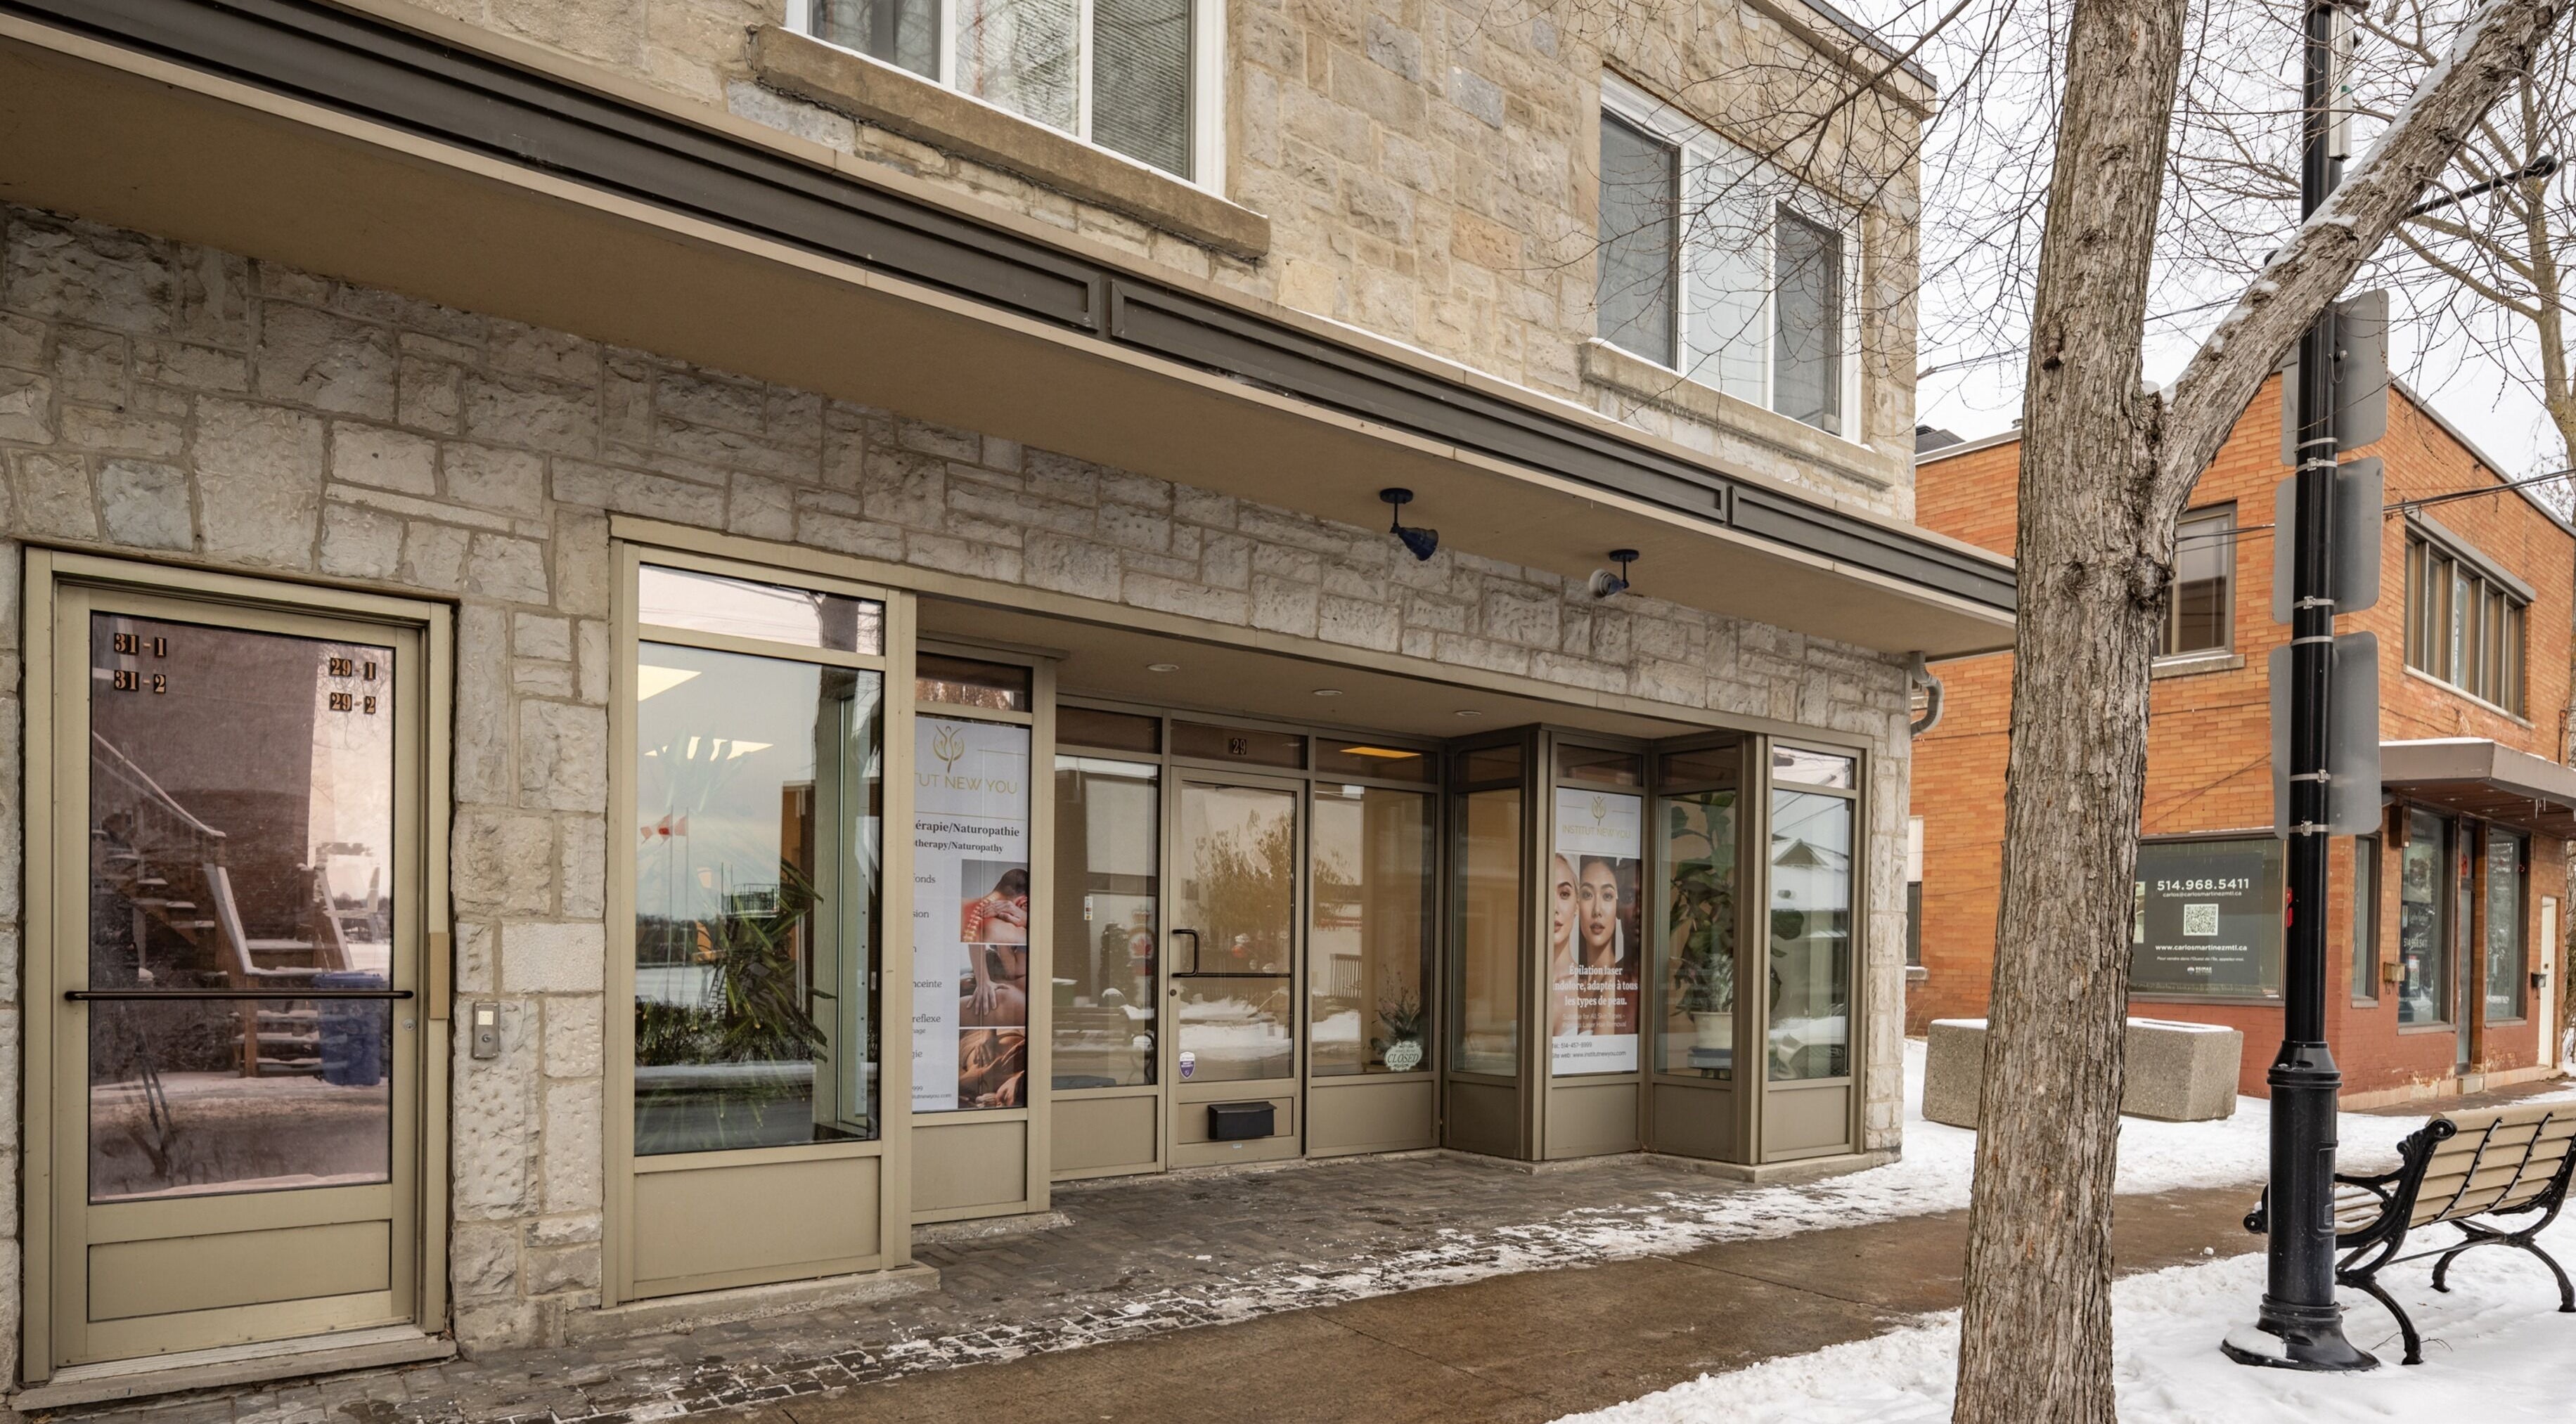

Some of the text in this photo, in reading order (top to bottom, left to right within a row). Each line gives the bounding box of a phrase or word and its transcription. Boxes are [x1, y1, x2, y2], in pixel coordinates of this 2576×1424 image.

[115, 633, 165, 656] 31-1
[331, 659, 375, 680] 29-1
[115, 671, 165, 693] 31-2
[331, 693, 375, 713] 29-2
[1232, 739, 1247, 755] 29
[945, 775, 982, 791] NEW
[986, 779, 1018, 795] YOU
[1561, 824, 1631, 839] INSTITUT NEW YOU
[2157, 878, 2249, 891] 514.968.5411
[1569, 962, 1623, 976] Épilation laser
[1587, 980, 1615, 992] adaptée
[1616, 980, 1621, 990] à
[1623, 981, 1638, 990] tous
[1564, 995, 1628, 1008] les types de peau.
[1387, 1054, 1418, 1063] CLOSED
